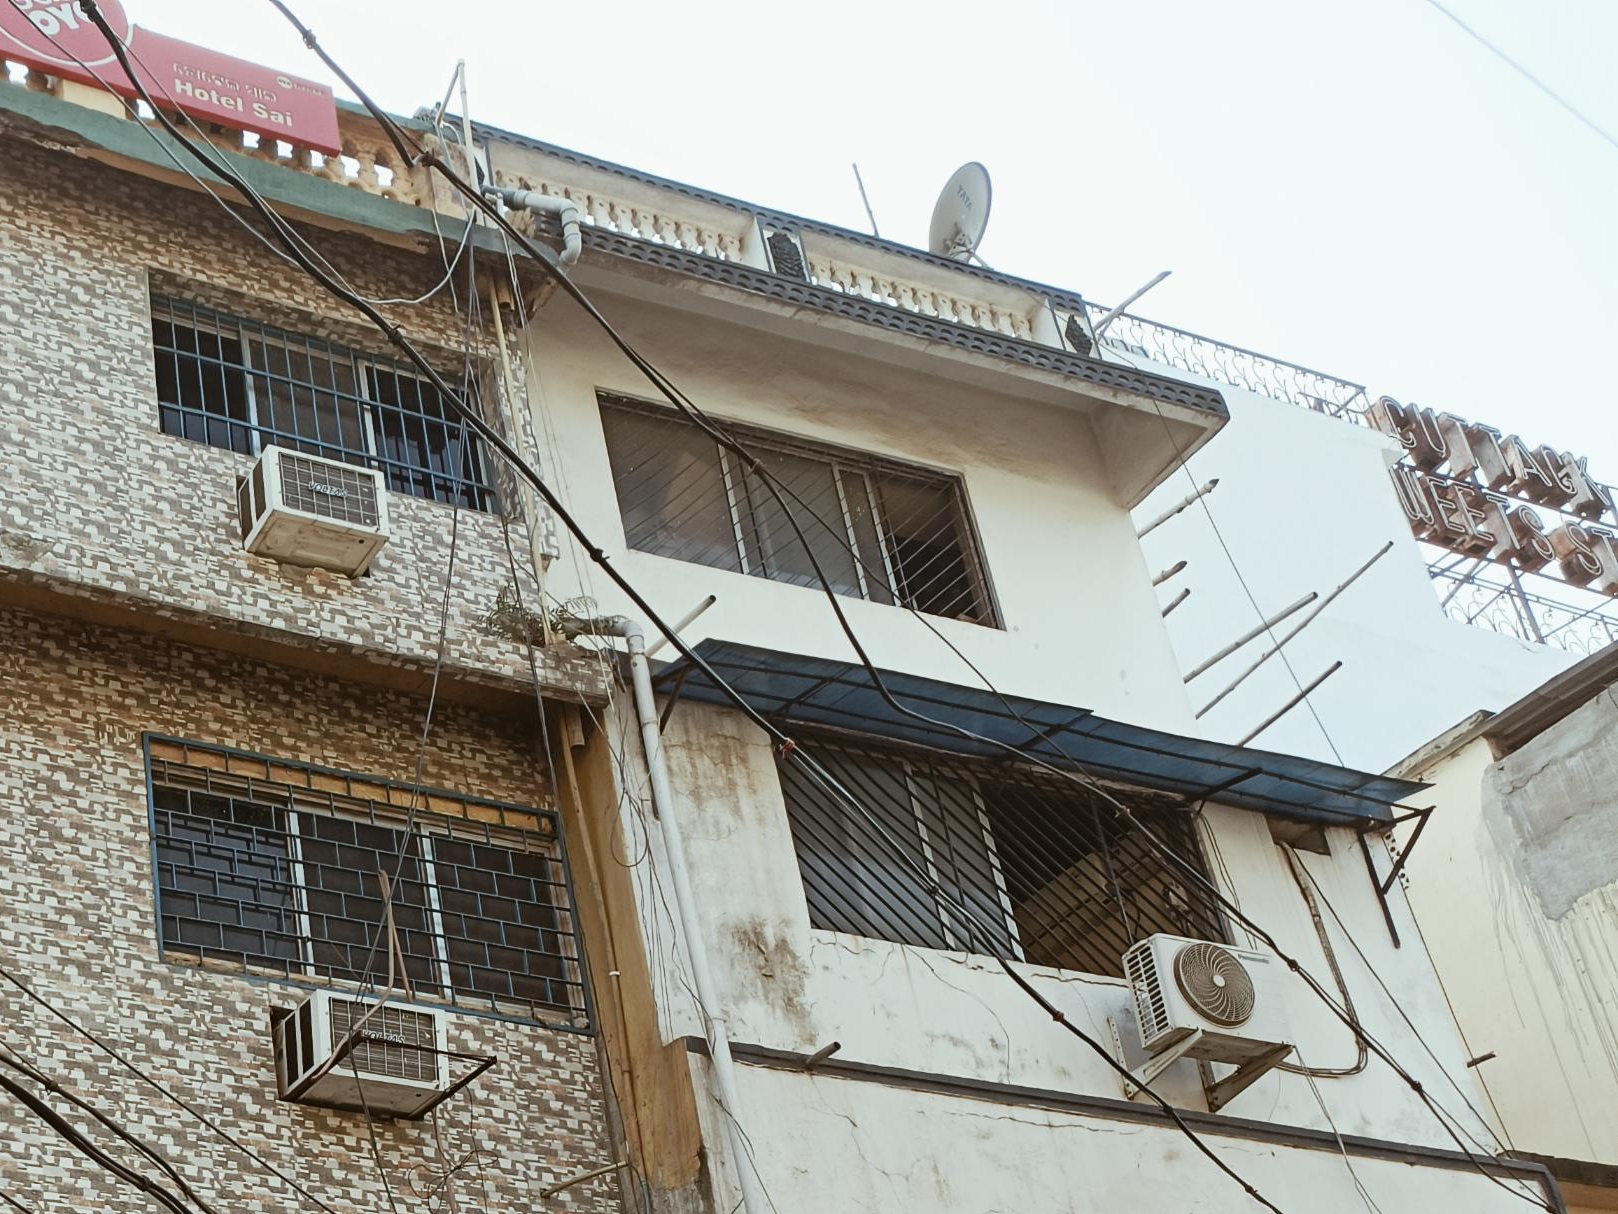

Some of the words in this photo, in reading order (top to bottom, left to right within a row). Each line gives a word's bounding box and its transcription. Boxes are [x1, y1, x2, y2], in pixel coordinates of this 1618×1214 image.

[174, 79, 244, 113] Hotel
[253, 102, 293, 127] Sai
[1378, 395, 1612, 507] CUTTACK
